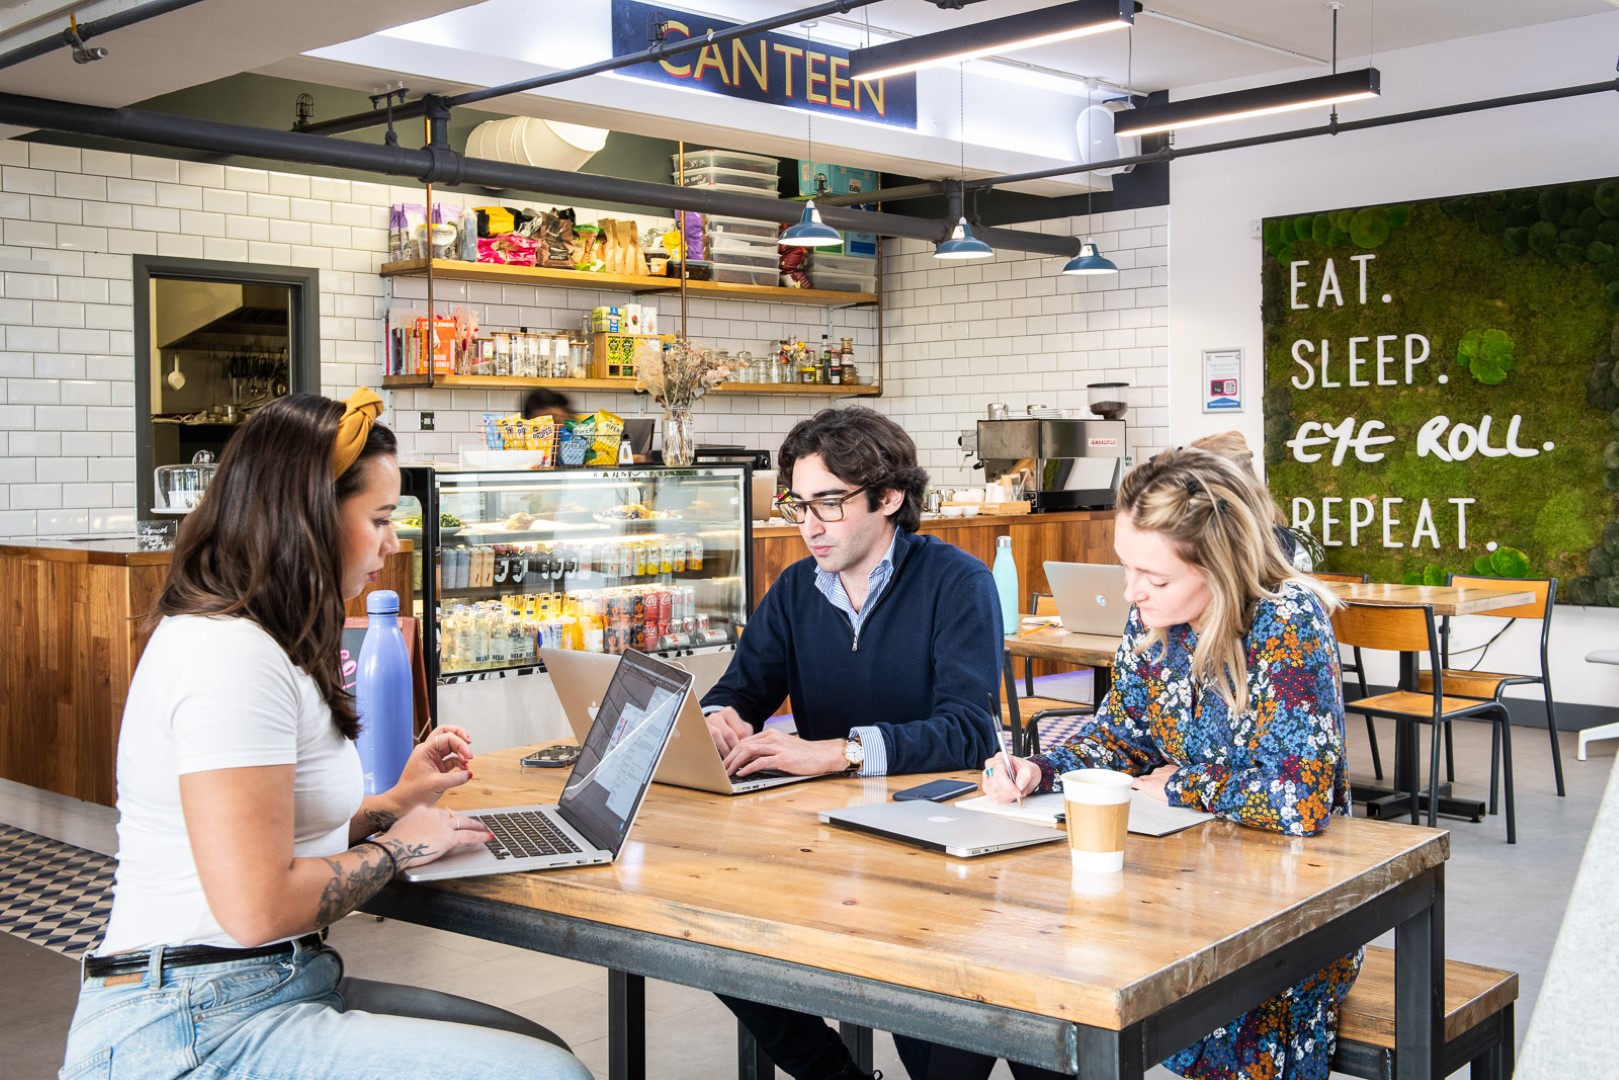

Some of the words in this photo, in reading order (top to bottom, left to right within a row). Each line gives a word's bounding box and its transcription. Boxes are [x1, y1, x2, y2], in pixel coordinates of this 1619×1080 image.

[656, 20, 885, 116] CANTEEN
[1290, 254, 1392, 310] EAT.
[1291, 334, 1449, 390] SLEEP.
[1287, 417, 1396, 466] EYE
[1416, 414, 1555, 463] ROLL.
[1292, 497, 1498, 552] REPEAT.
